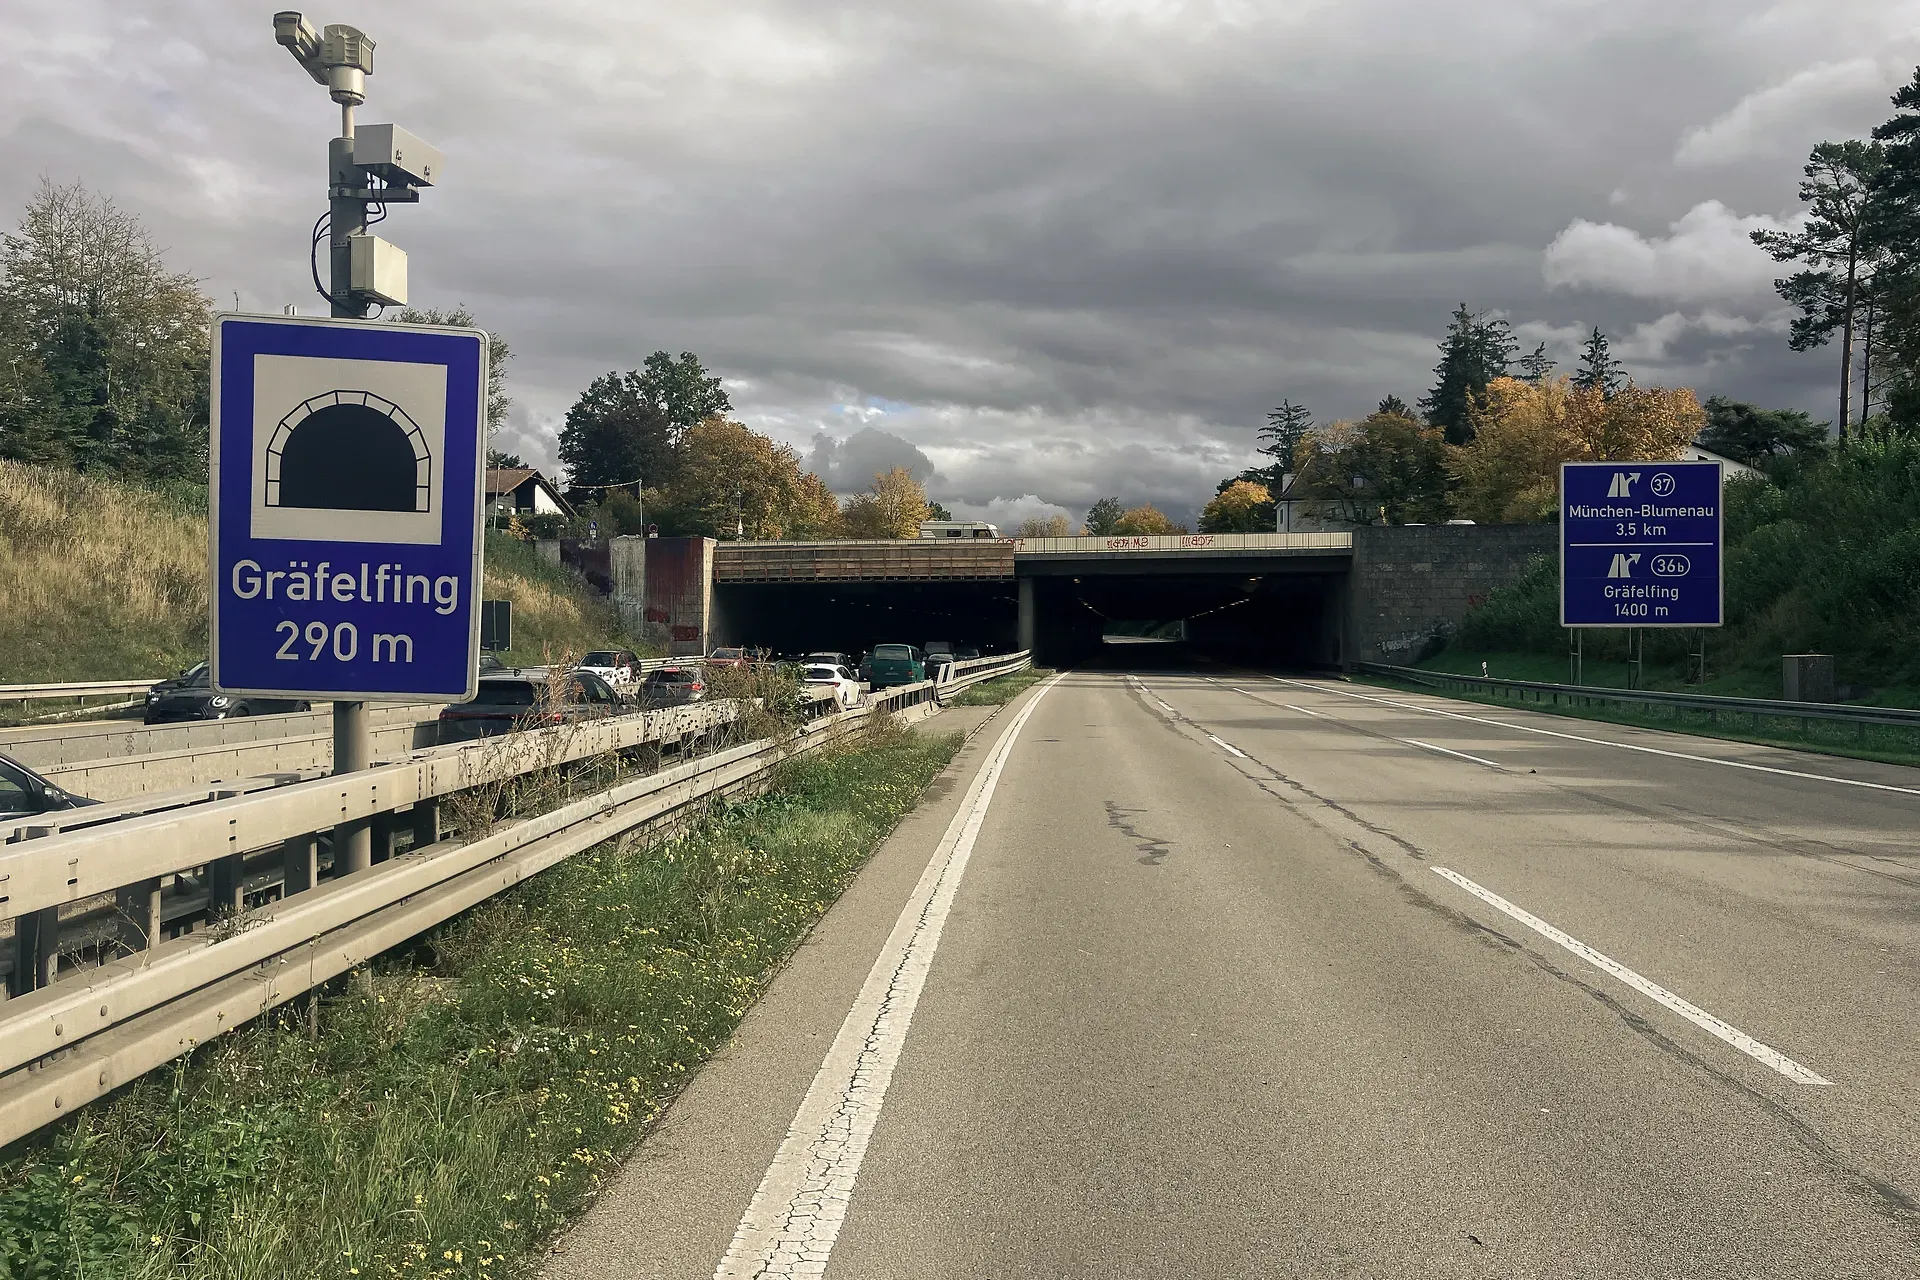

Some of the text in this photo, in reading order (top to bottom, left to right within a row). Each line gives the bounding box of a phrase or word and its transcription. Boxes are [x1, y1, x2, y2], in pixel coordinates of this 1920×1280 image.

[1654, 479, 1671, 491] 37
[1569, 504, 1714, 518] München-Blumenau
[1616, 523, 1667, 536] 3,5 km
[1657, 559, 1684, 573] 36b
[232, 559, 459, 615] Gräfelfing
[1604, 585, 1679, 600] Gräfelfing
[1614, 603, 1669, 616] 1400 m
[275, 620, 413, 662] 290 m
